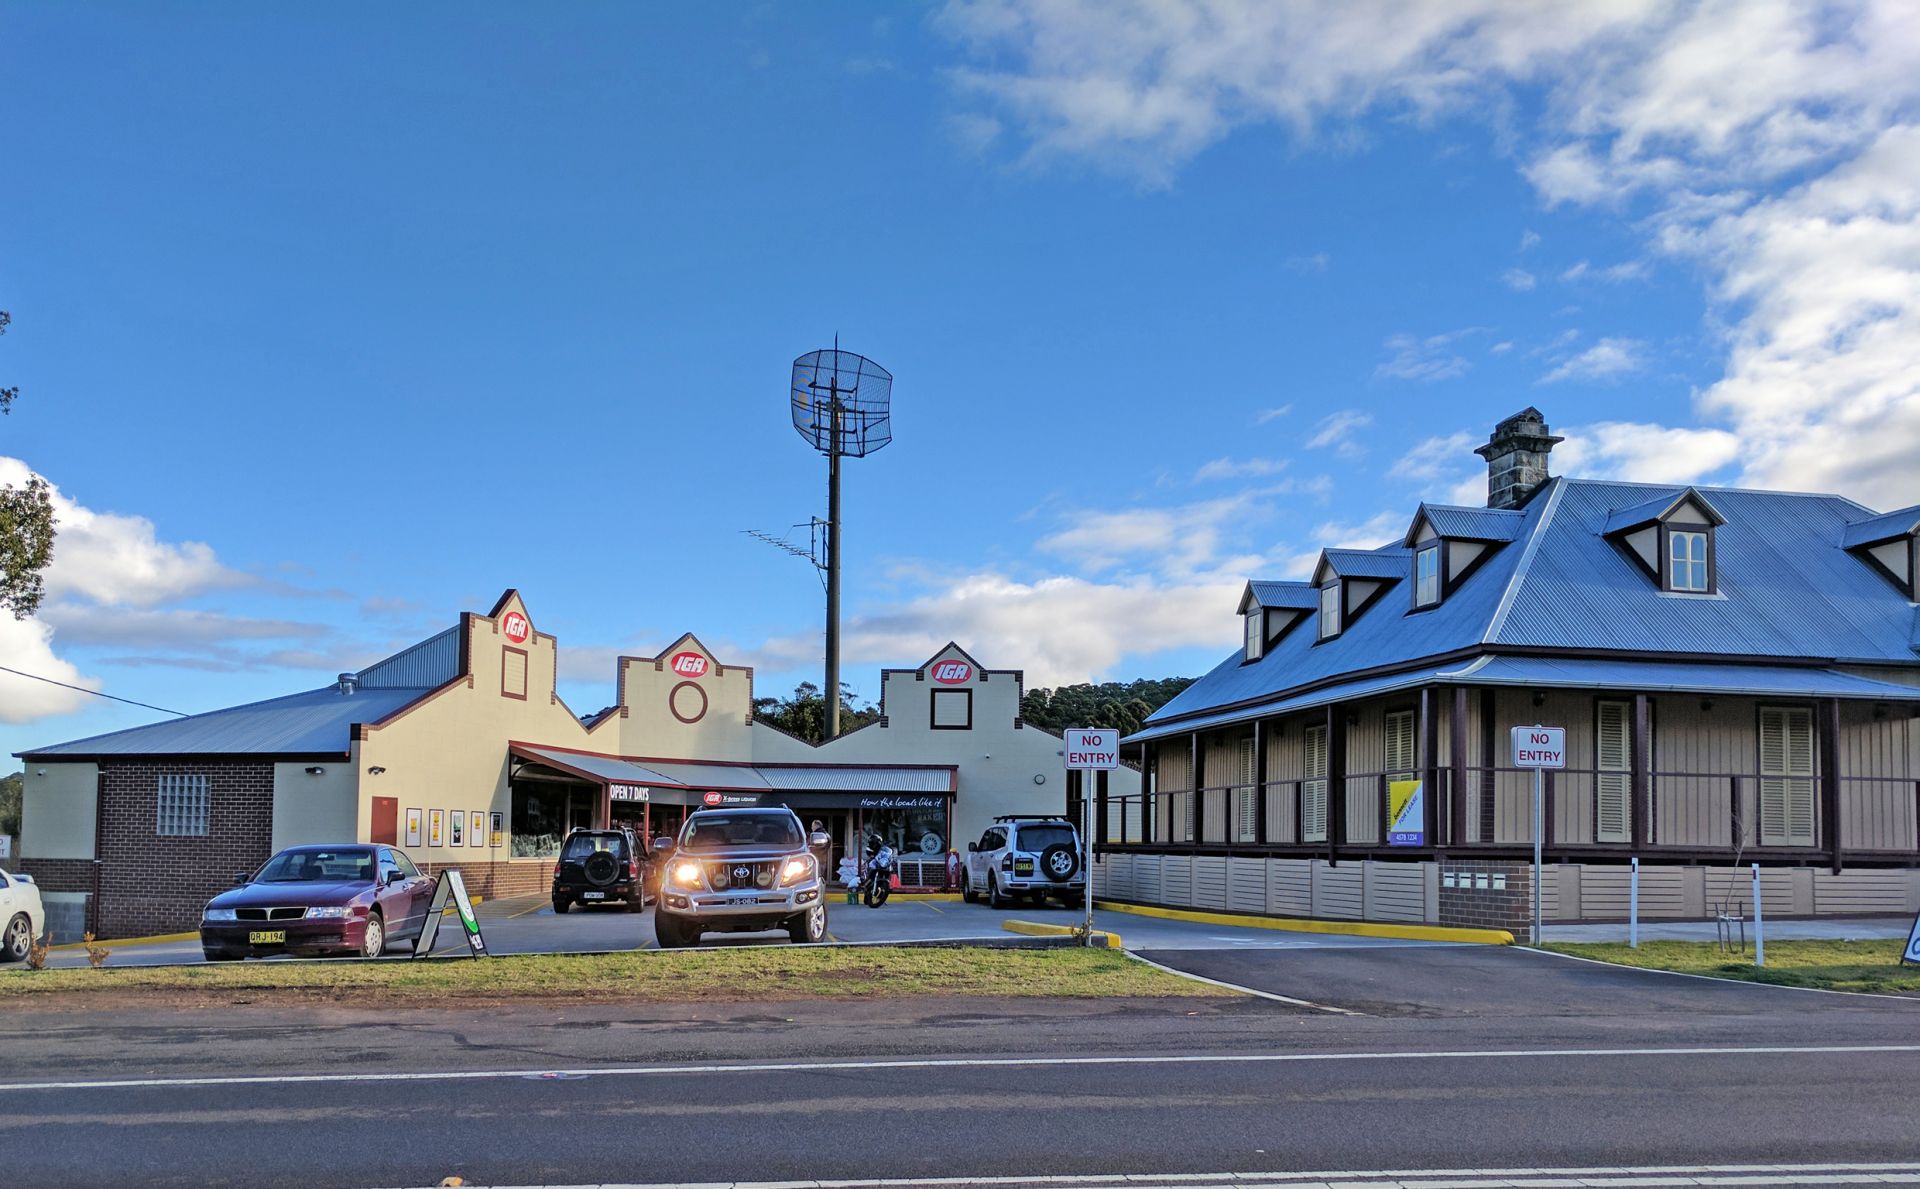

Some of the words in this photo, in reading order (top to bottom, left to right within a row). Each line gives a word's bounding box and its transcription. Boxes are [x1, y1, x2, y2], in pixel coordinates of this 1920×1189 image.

[506, 616, 526, 637] IGA
[674, 656, 705, 672] IGA
[935, 664, 968, 679] IGA
[1082, 735, 1102, 746] NO
[1532, 733, 1549, 744] NO
[1069, 752, 1114, 763] ENTRY
[1519, 750, 1560, 761] ENTRY
[610, 784, 628, 799] OPEN
[629, 786, 633, 799] 7
[634, 786, 649, 801] DAYS
[860, 798, 879, 806] How
[880, 797, 893, 807] the
[895, 797, 916, 807] locals
[918, 797, 933, 807] like
